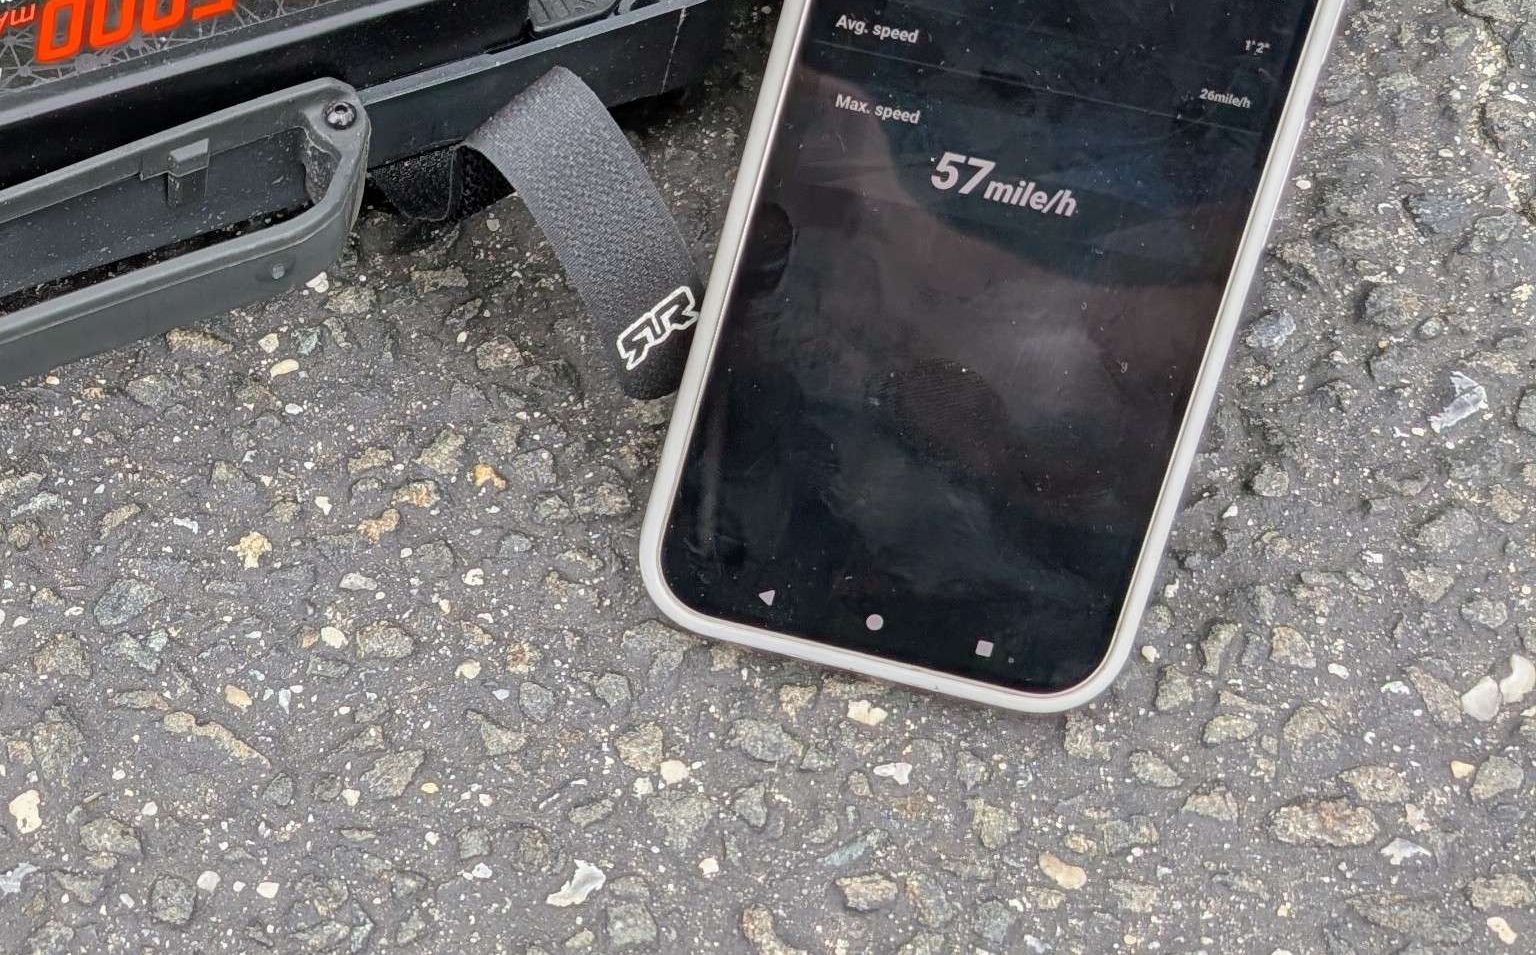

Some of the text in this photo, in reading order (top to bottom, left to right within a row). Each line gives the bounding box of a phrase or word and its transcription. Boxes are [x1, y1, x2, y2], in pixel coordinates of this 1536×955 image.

[835, 14, 919, 44] Avg. speed
[835, 93, 920, 124] Max. speed
[1200, 88, 1250, 109] 26mile/h
